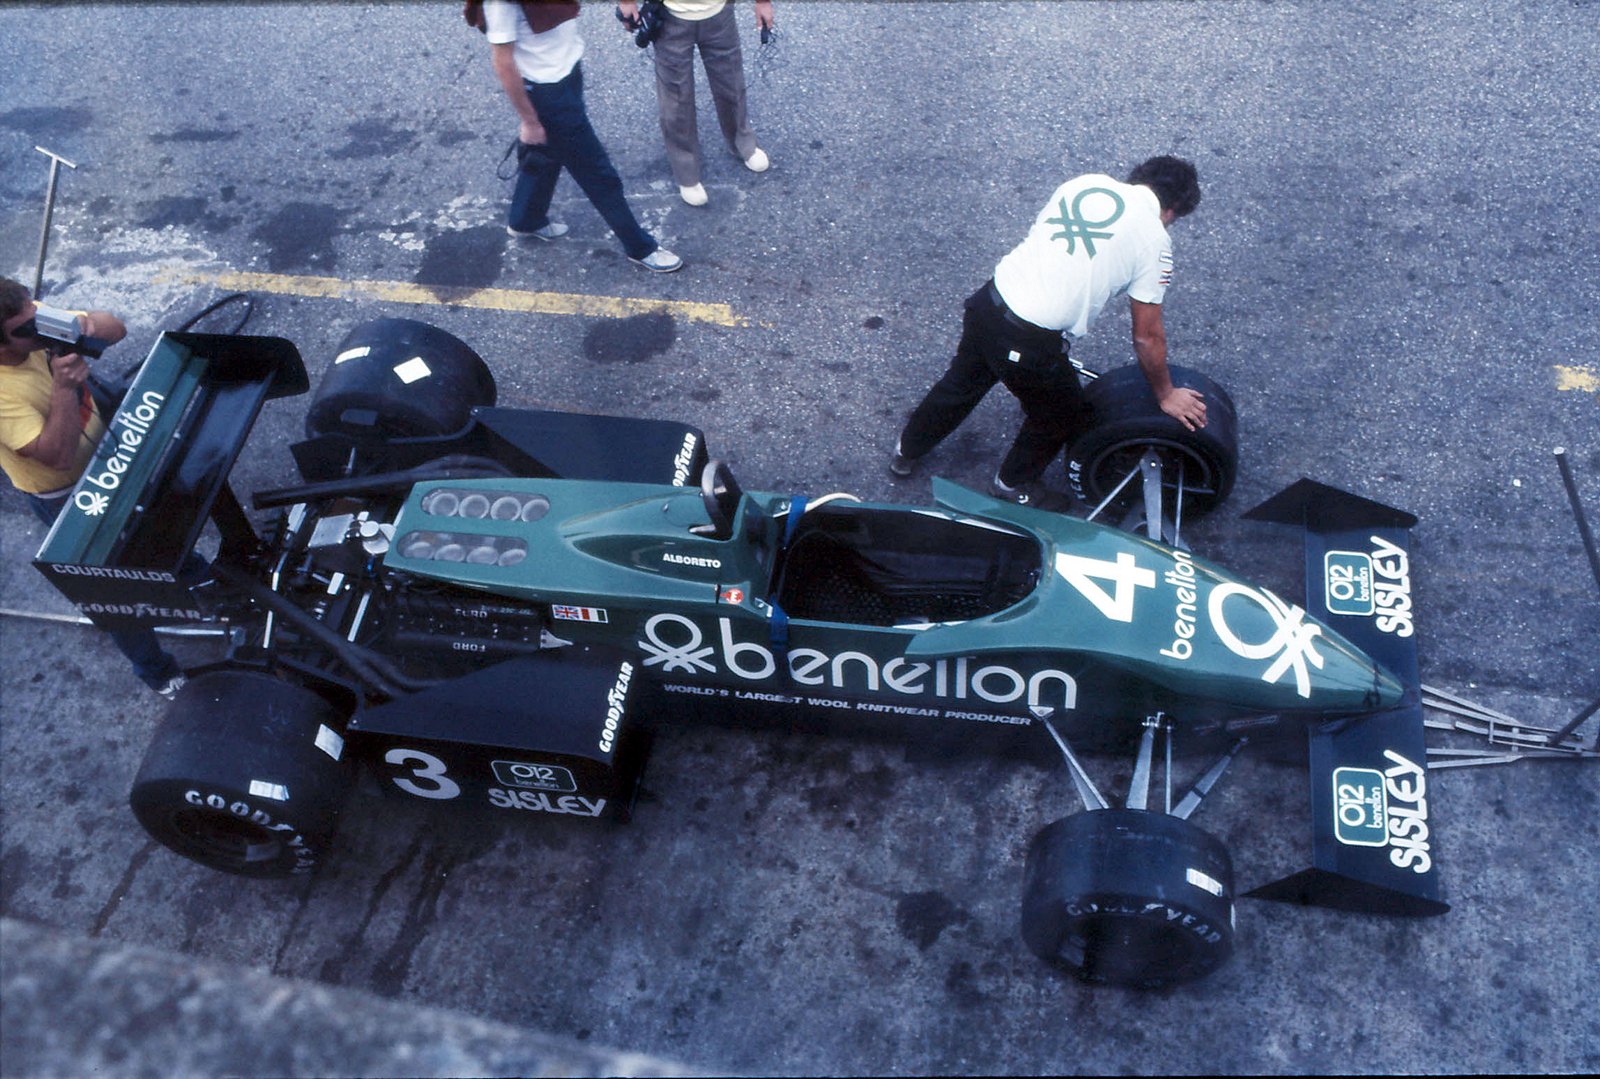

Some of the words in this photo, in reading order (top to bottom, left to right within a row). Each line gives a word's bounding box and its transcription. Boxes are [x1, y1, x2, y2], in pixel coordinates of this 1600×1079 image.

[87, 390, 164, 491] benetton
[672, 432, 697, 487] ODYEAR
[52, 564, 176, 583] COURTAULDS
[662, 553, 722, 568] ALBORETO
[1055, 552, 1156, 623] 4
[1355, 566, 1369, 602] benetton
[1370, 536, 1413, 638] SISLEY
[1160, 550, 1192, 660] benetton
[719, 617, 1077, 709] benetton
[599, 661, 633, 753] GOODYEAR
[664, 683, 729, 697] WORLD'S
[735, 690, 803, 704] LARGEST
[808, 698, 852, 709] WOOL
[856, 703, 939, 718] KNITWEAR
[945, 711, 1031, 725] PRODUCER
[384, 748, 460, 800] 3
[488, 787, 606, 817] SISLEY
[1367, 786, 1381, 829] benetton
[1383, 749, 1431, 873] SISLEY
